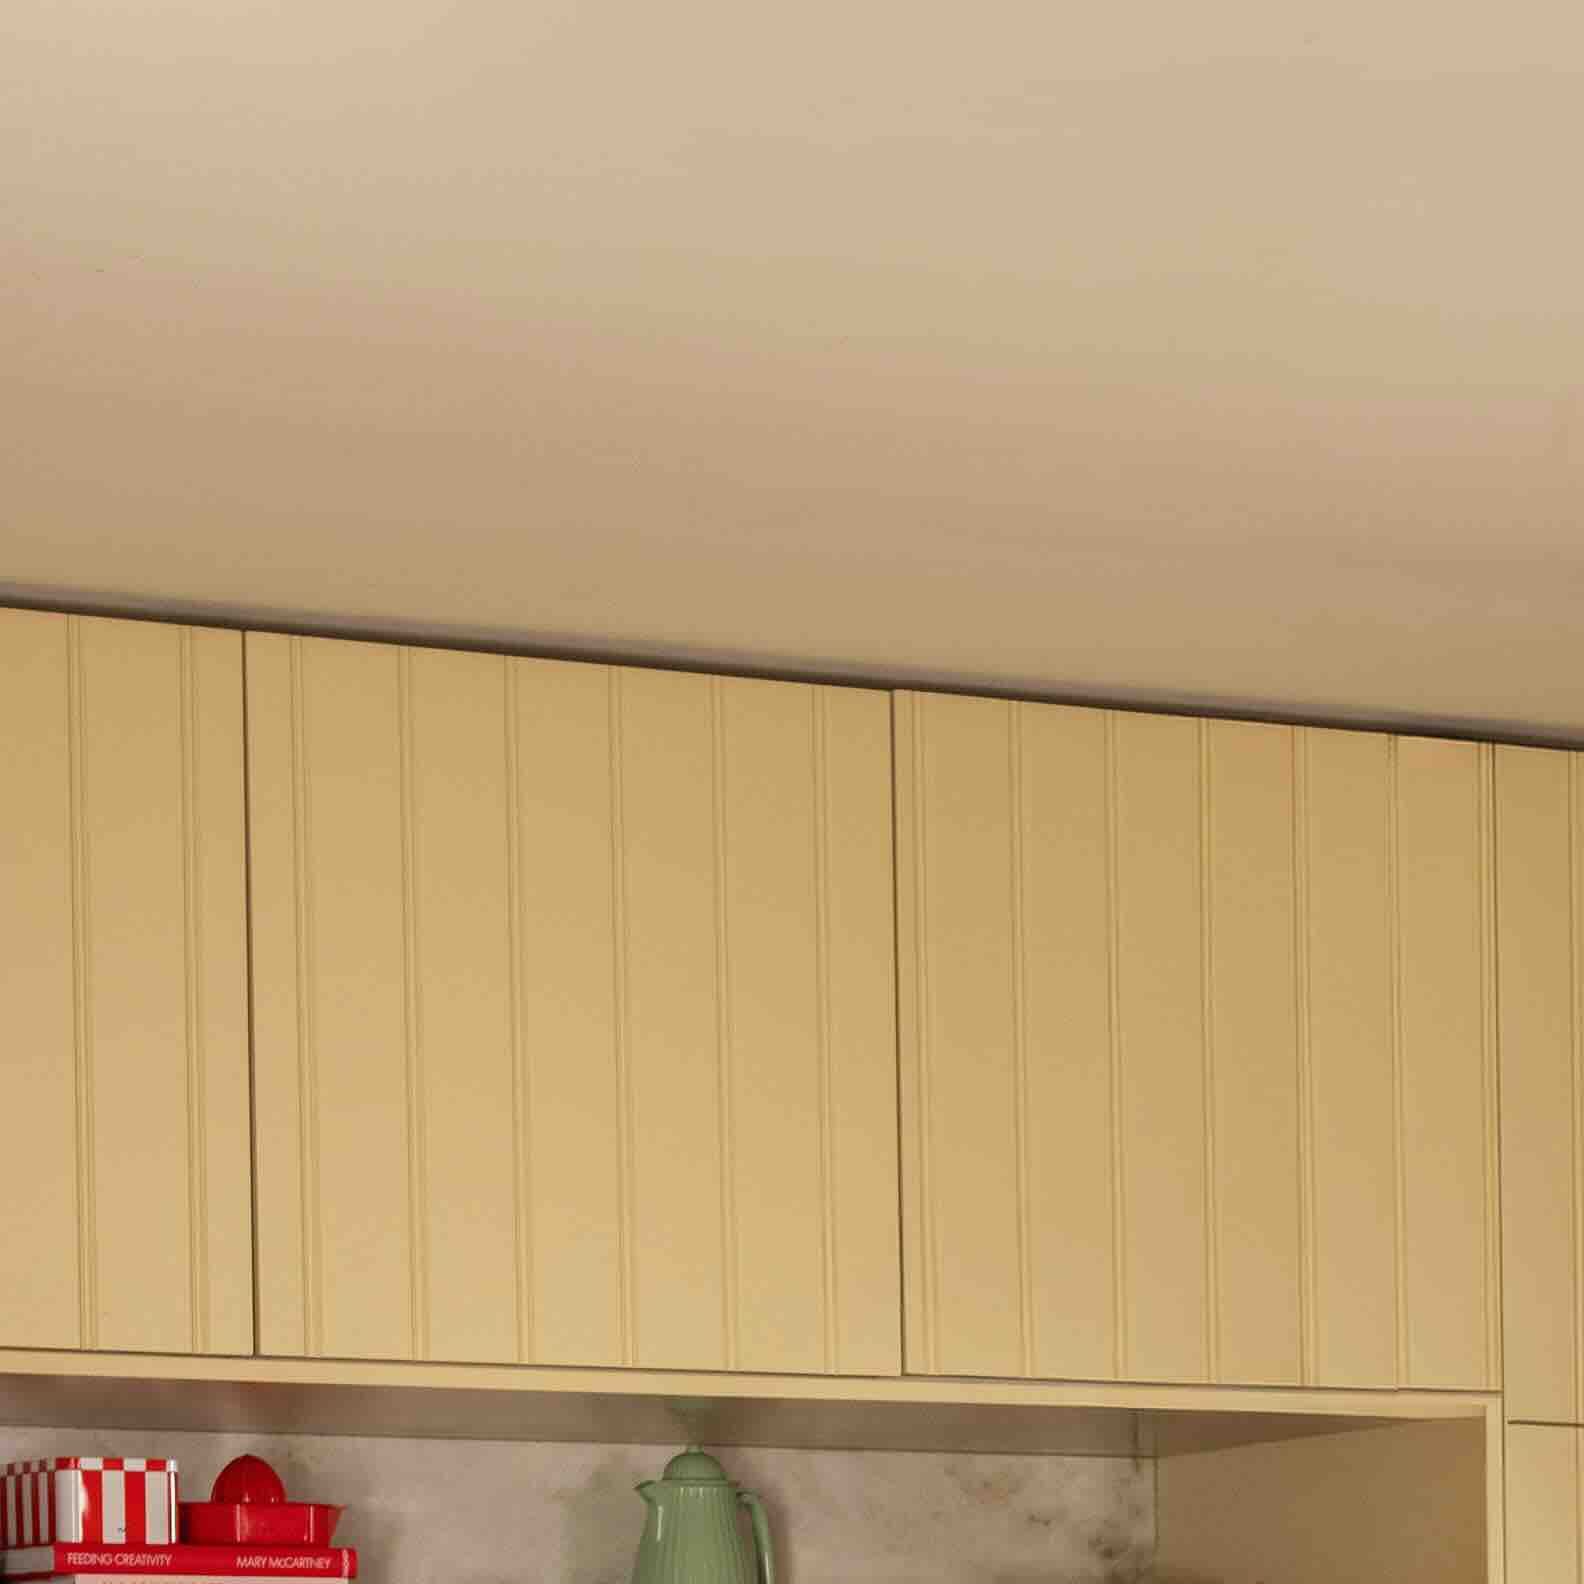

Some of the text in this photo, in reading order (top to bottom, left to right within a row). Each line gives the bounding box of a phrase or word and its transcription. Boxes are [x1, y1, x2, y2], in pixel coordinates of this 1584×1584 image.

[66, 1552, 172, 1567] FEEDING CREATIVITY
[236, 1556, 267, 1568] MARY
